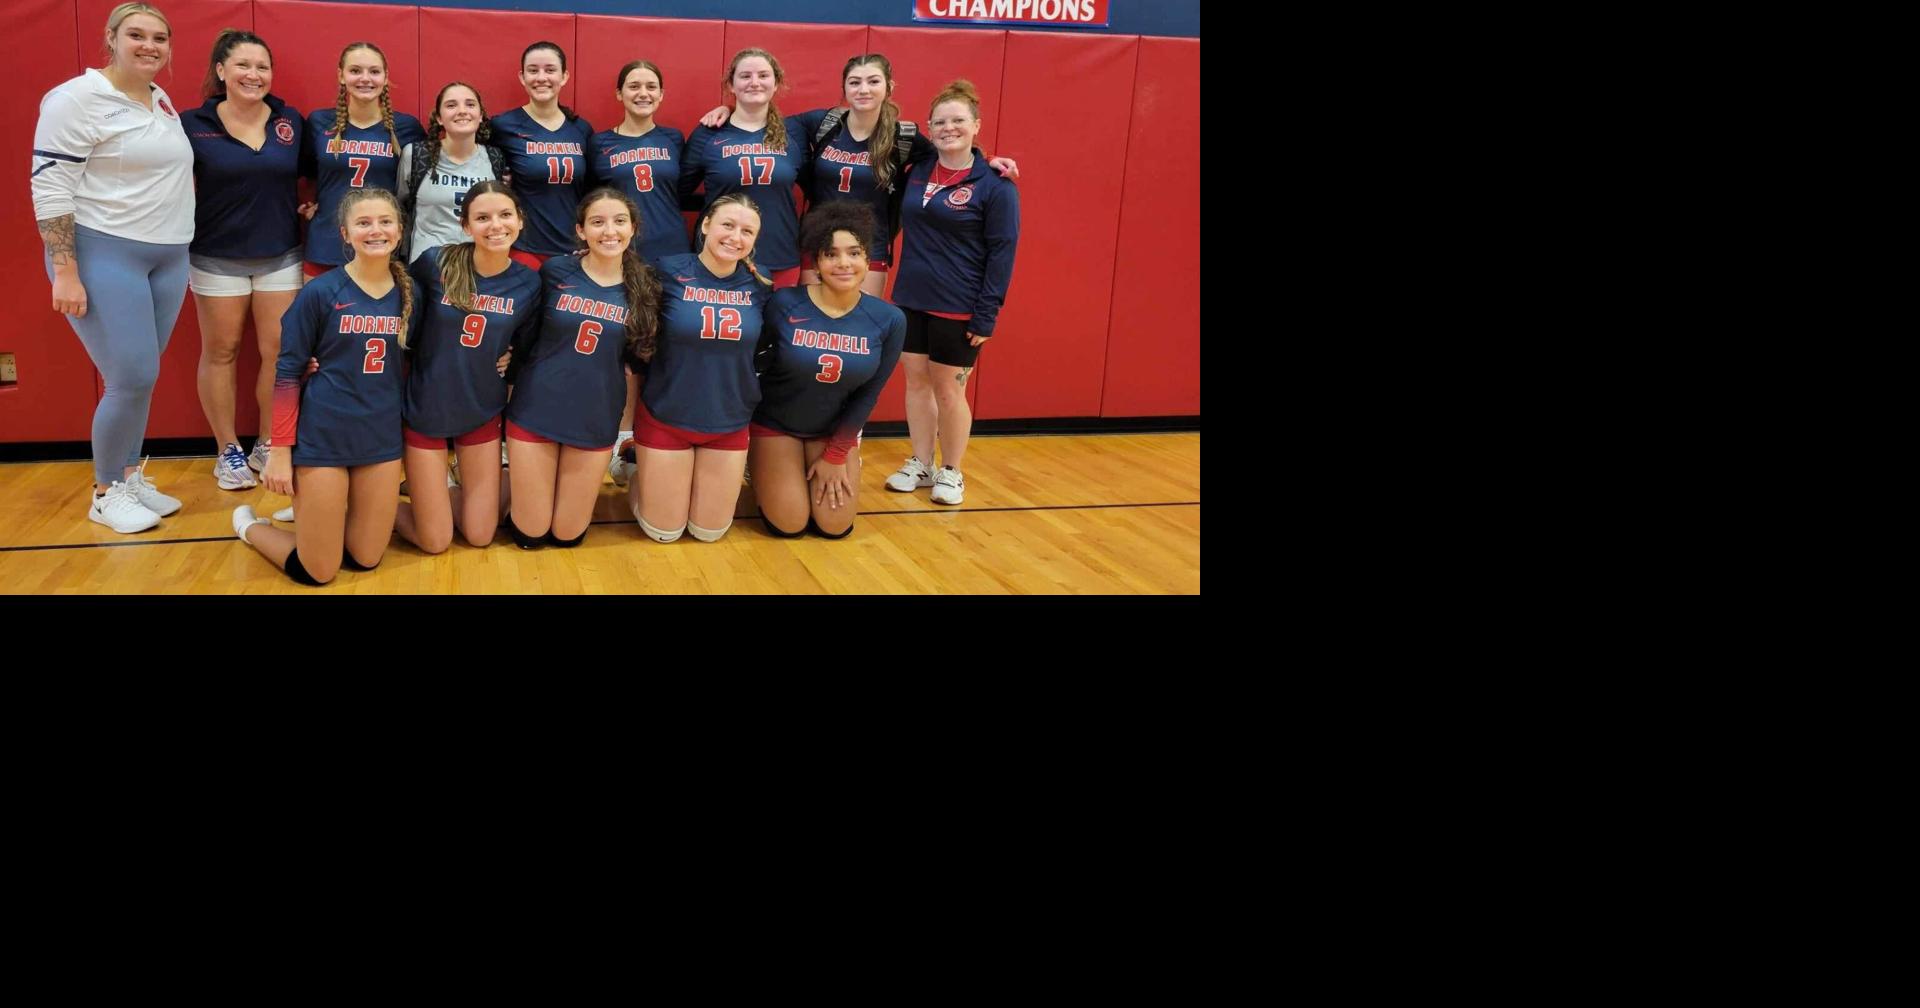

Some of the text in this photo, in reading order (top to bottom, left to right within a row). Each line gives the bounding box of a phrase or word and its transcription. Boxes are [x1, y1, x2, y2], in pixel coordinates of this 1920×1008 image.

[929, 0, 1095, 21] CHAMPIONS
[526, 141, 582, 155] HORNELL
[609, 147, 671, 168] HORNELL
[821, 145, 872, 166] HORNEL
[349, 157, 370, 187] 7
[547, 157, 574, 184] 11
[633, 163, 654, 192] 8
[738, 156, 775, 185] 17
[838, 167, 853, 192] 1
[683, 286, 752, 306] HORNELL
[339, 314, 402, 335] HORNEL
[460, 313, 487, 348] 9
[700, 306, 742, 341] 12
[575, 320, 603, 355] 6
[792, 328, 870, 355] HORNELL
[363, 337, 387, 374] 2
[815, 353, 843, 384] 3
